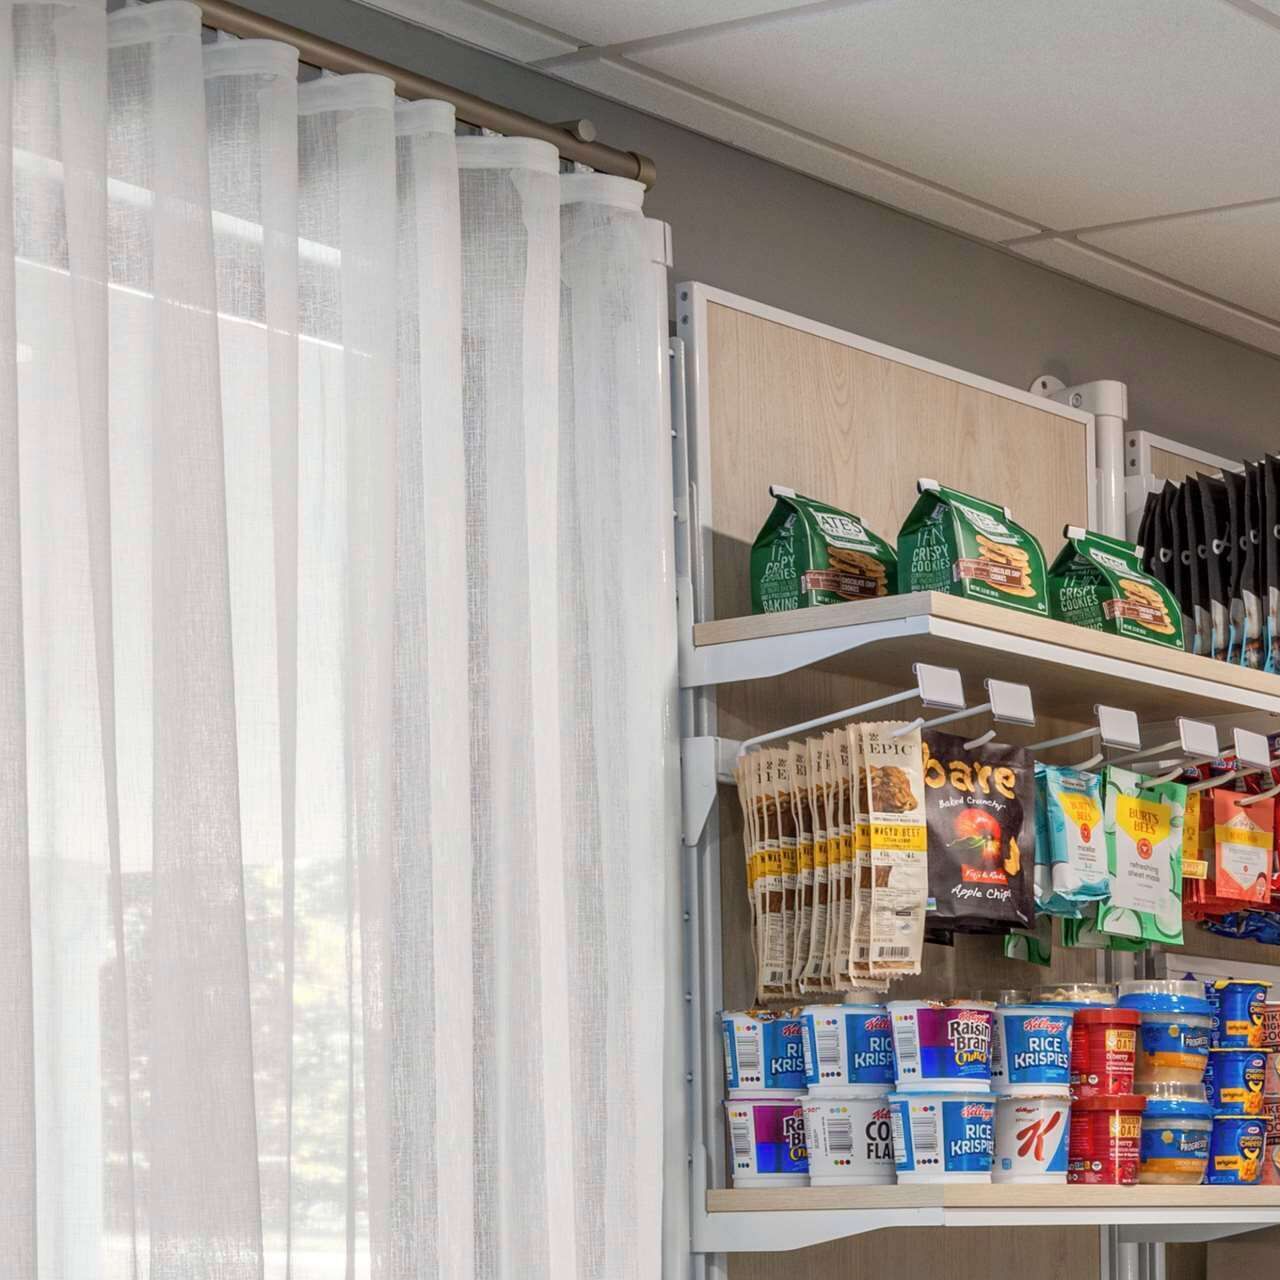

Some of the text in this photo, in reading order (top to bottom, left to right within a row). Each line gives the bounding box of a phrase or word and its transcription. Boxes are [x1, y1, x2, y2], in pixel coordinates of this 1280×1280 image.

[869, 743, 912, 755] EPIC
[922, 742, 1016, 799] bare
[952, 884, 983, 899] Apple
[1028, 1037, 1061, 1052] RICE
[1014, 1053, 1069, 1070] KRISPIES
